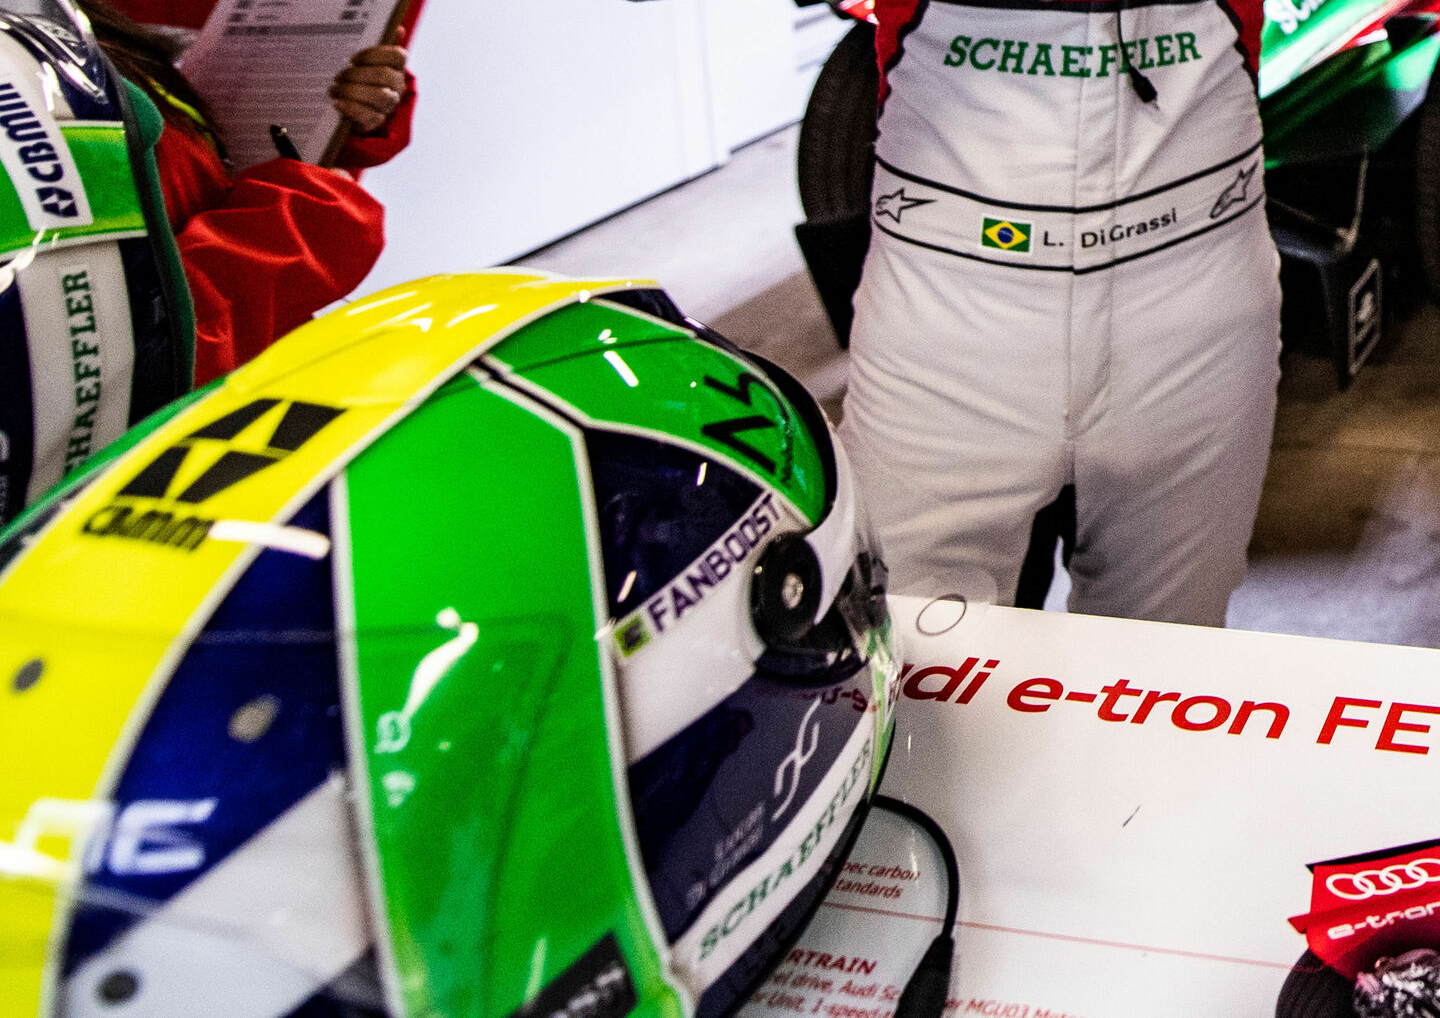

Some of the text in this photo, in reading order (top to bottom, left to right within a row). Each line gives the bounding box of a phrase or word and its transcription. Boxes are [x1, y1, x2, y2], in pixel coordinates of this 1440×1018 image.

[942, 31, 1203, 79] SCHAEFFLER
[1042, 230, 1065, 248] L.
[61, 270, 102, 473] HAEFFLER
[646, 491, 782, 634] FANBOOST
[900, 656, 1001, 705] di
[1006, 678, 1291, 740] e-tron
[834, 878, 904, 900] tandards
